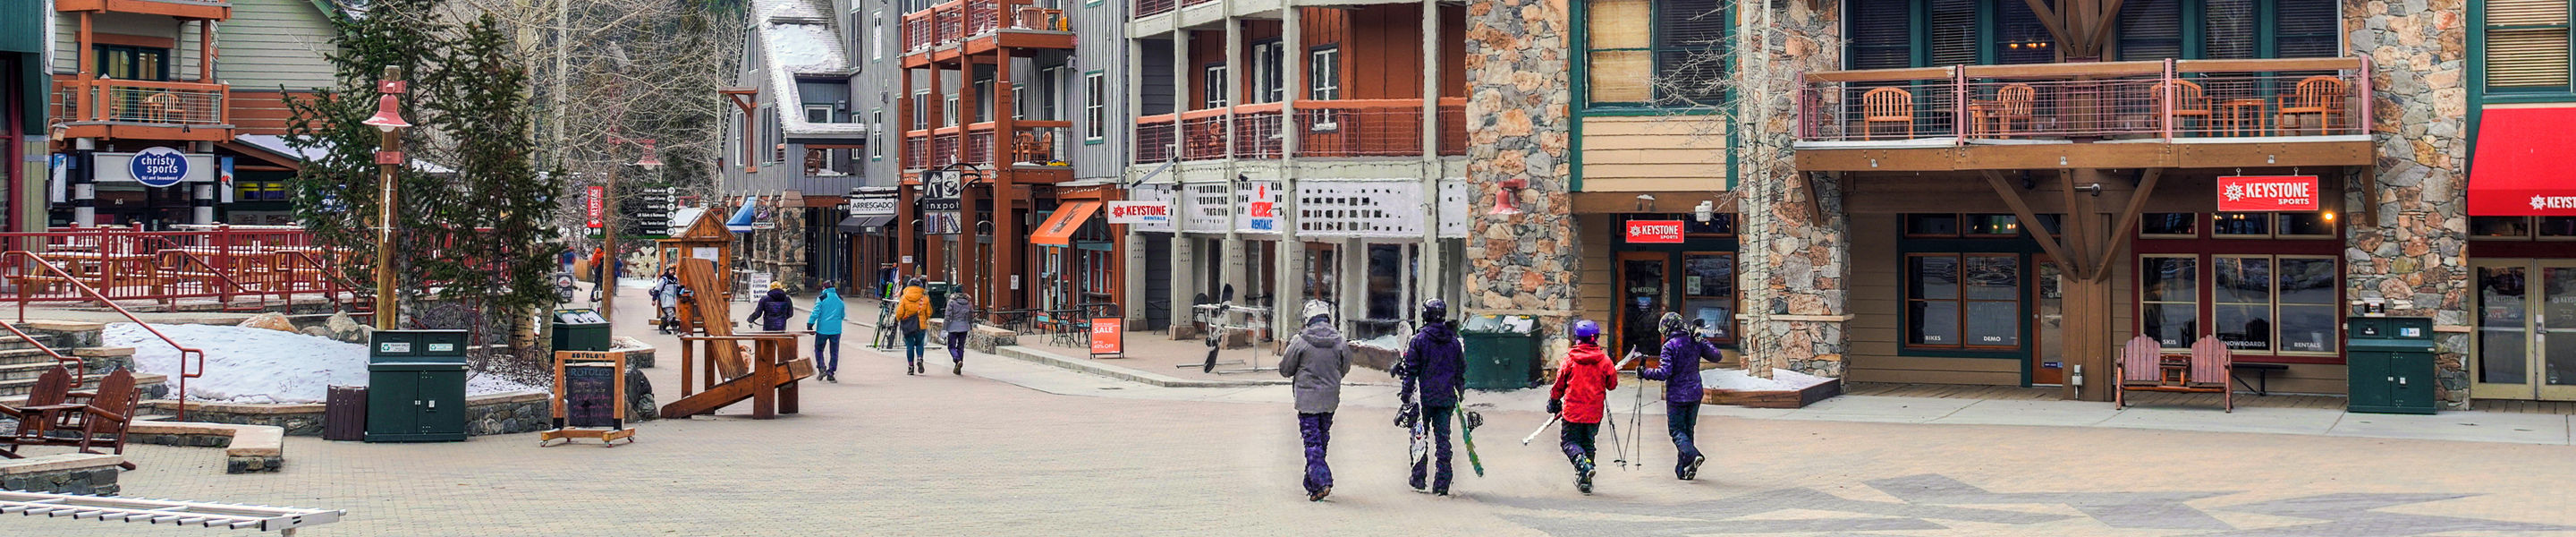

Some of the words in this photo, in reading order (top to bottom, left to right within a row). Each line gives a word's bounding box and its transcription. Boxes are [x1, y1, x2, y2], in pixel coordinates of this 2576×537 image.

[141, 156, 176, 166] christy
[147, 165, 178, 175] sports
[2246, 183, 2309, 198] KEYSTONE
[927, 200, 959, 211] inxpot
[1126, 206, 1166, 216] KEYSTONE
[1642, 226, 1678, 234] KEYSTONE
